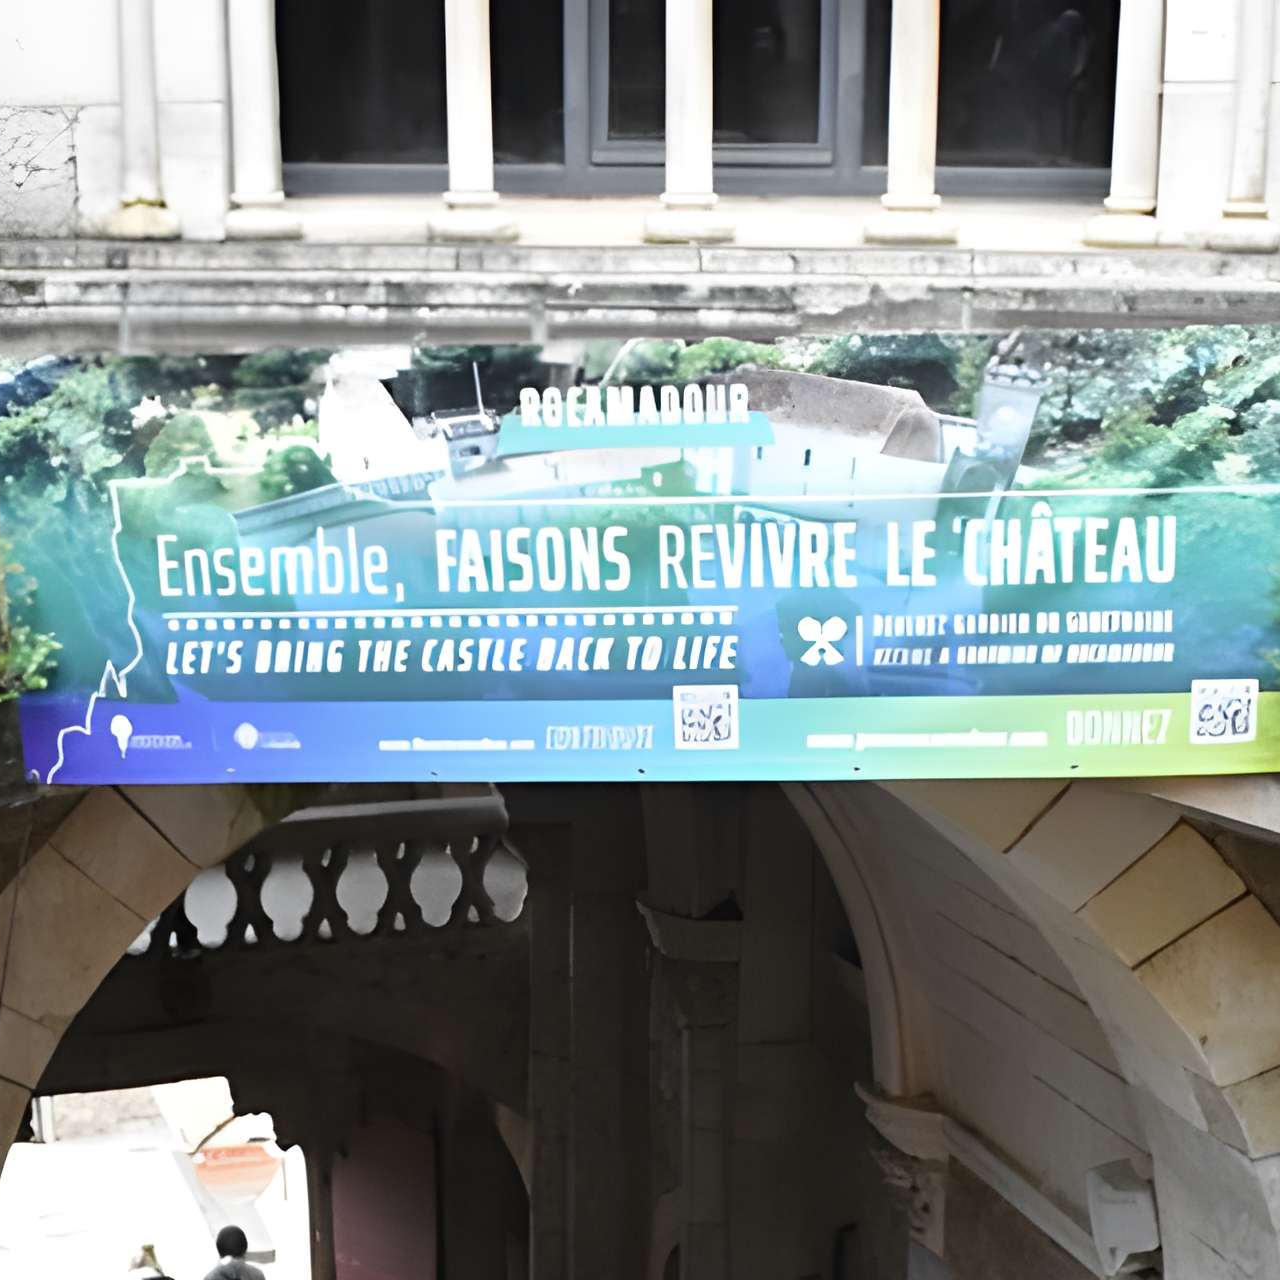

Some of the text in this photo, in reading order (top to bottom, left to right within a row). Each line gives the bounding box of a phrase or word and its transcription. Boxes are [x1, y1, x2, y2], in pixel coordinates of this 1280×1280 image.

[156, 500, 1176, 602] Ensemble, FAISONS REVIVRE LE CHÂTEAU
[166, 639, 243, 675] LET'S
[358, 639, 412, 673] THE
[421, 637, 527, 673] CASTLE
[627, 635, 663, 671] TO
[672, 635, 739, 670] LIFE
